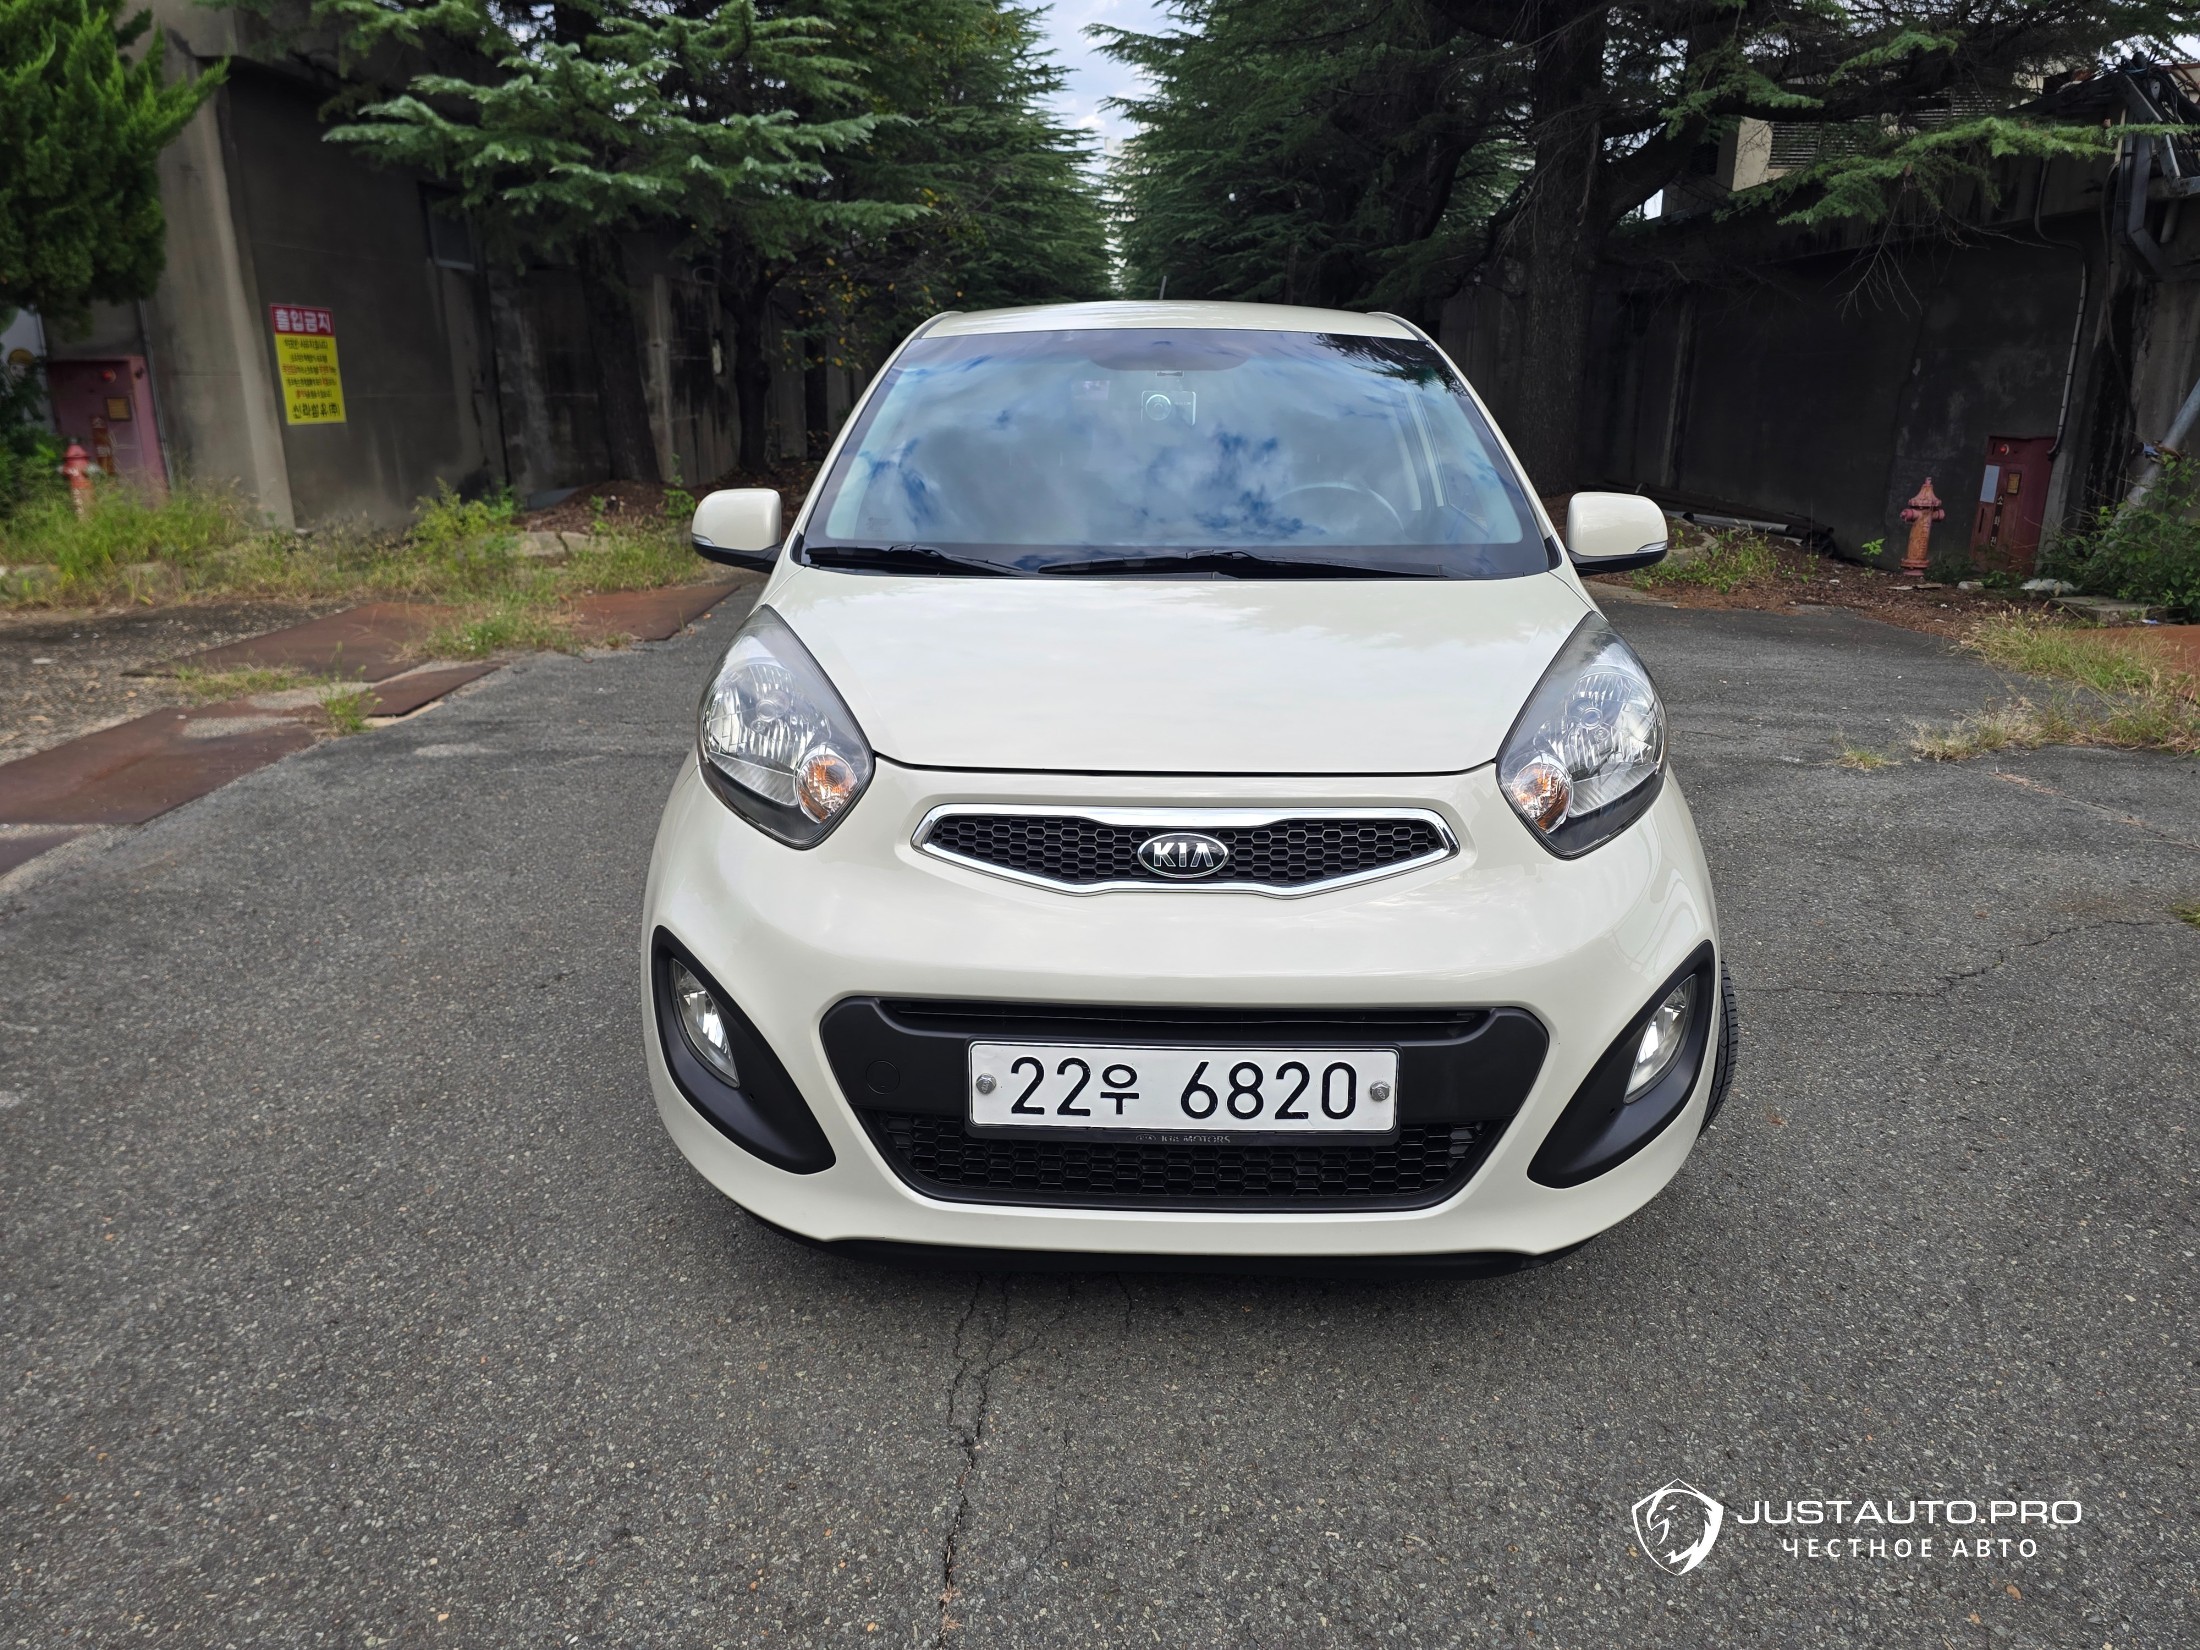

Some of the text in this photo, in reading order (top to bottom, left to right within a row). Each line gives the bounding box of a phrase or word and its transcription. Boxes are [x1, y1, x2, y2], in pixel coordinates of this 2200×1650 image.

[275, 308, 332, 334] 출입금지
[1152, 842, 1214, 868] KIA
[1010, 1056, 1357, 1120] 22우 6820
